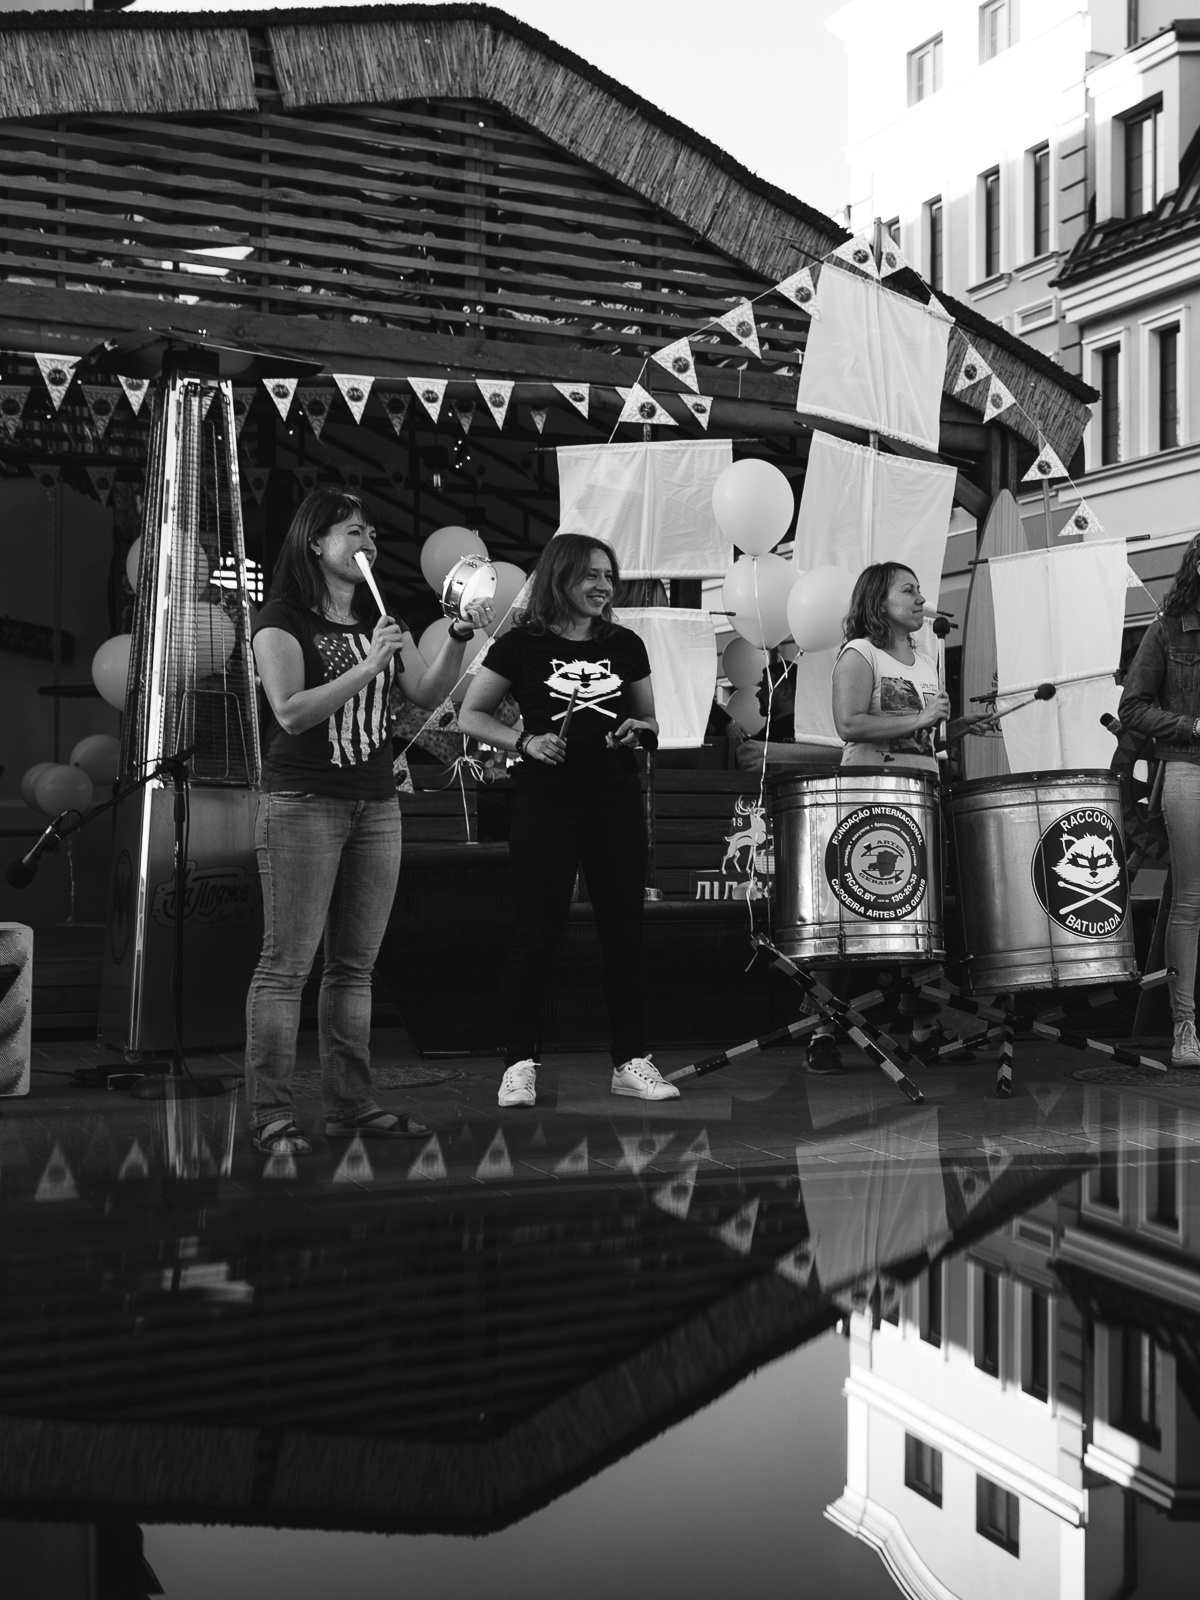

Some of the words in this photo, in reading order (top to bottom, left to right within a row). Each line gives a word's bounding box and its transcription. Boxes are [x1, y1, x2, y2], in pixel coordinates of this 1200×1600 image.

[732, 817, 743, 827] 18
[832, 809, 870, 845] FUNDAÇÃO
[872, 807, 923, 846] INTERNACIONAL
[1060, 810, 1113, 832] RACCOON
[845, 872, 876, 902] FICAG.BY
[891, 873, 918, 903] 130-20-33
[859, 872, 894, 885] GERAIS
[866, 908, 895, 918] ARTES
[896, 904, 912, 916] DAS
[910, 878, 926, 907] GERAIS
[1065, 913, 1121, 934] BATUCADA
